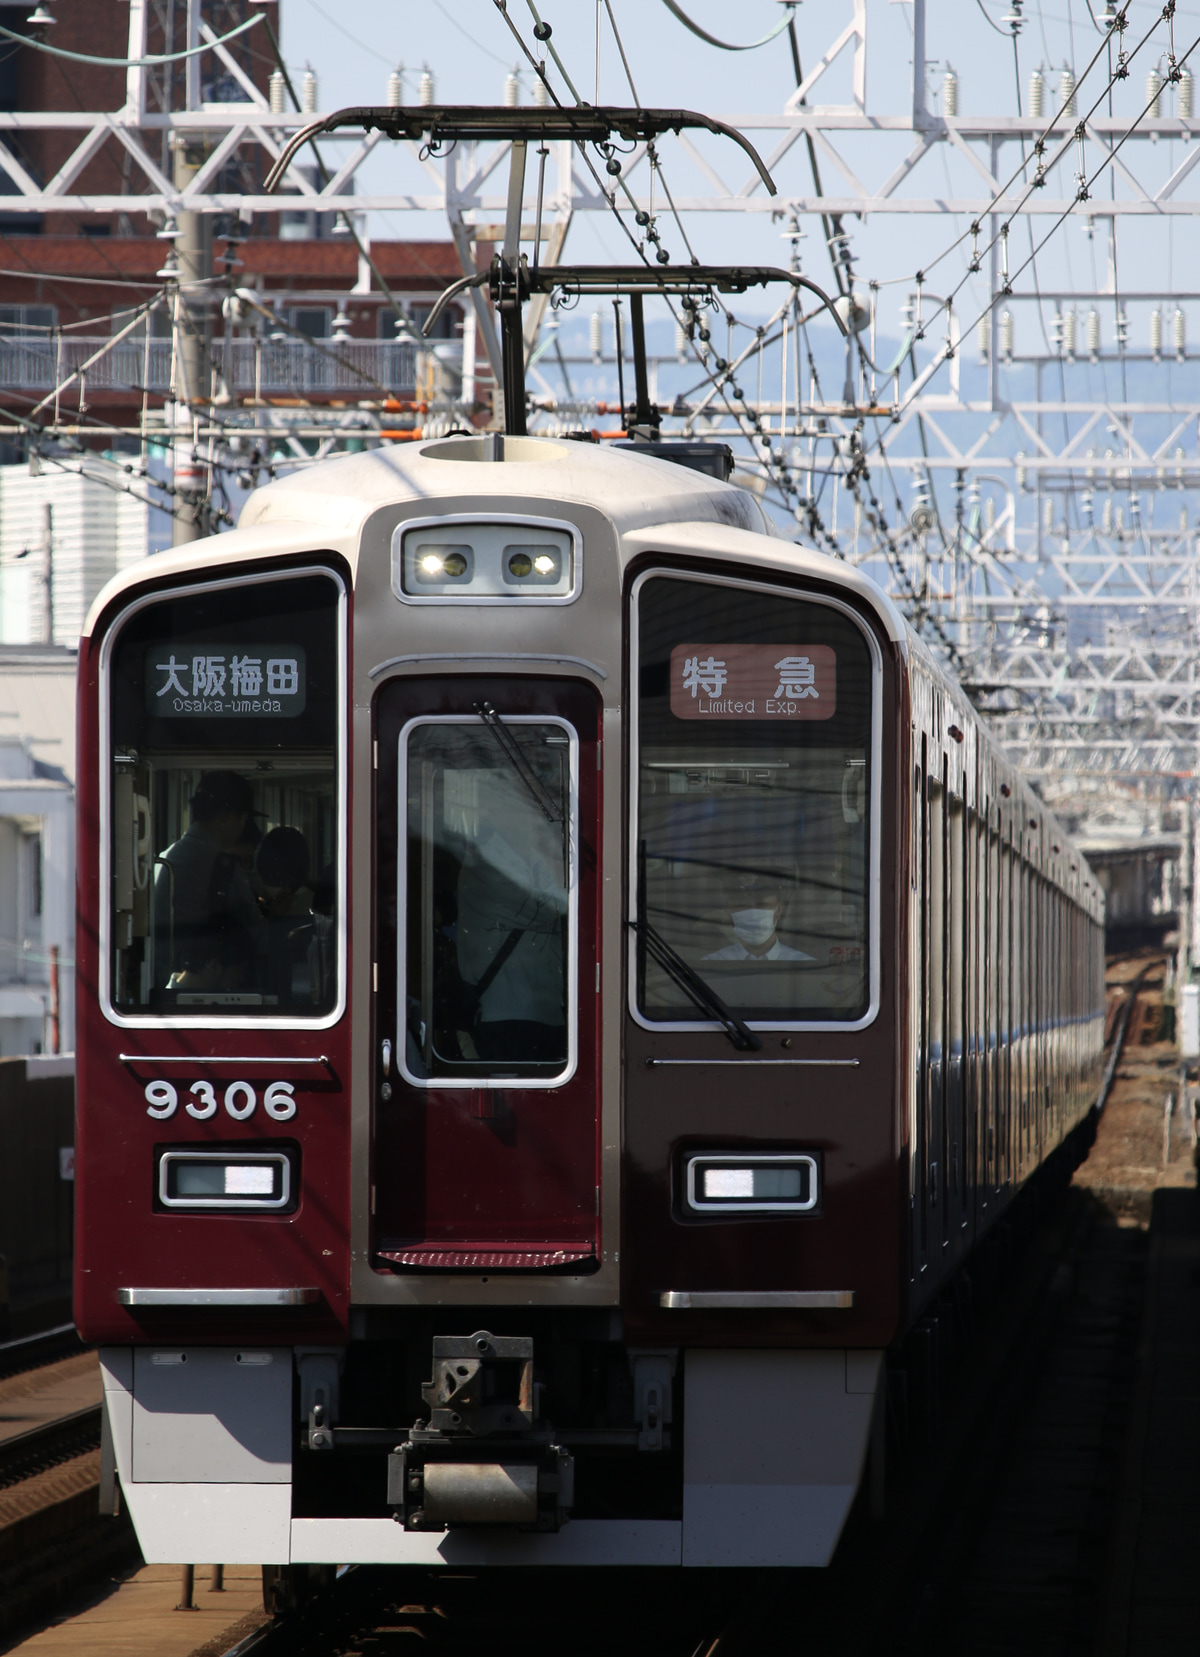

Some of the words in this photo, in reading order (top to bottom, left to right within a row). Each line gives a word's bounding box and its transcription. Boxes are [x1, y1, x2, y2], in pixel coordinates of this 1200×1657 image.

[156, 655, 298, 697] 大阪梅田
[698, 699, 755, 714] Limited
[765, 700, 801, 715] Exp.
[144, 1080, 297, 1121] 9306
